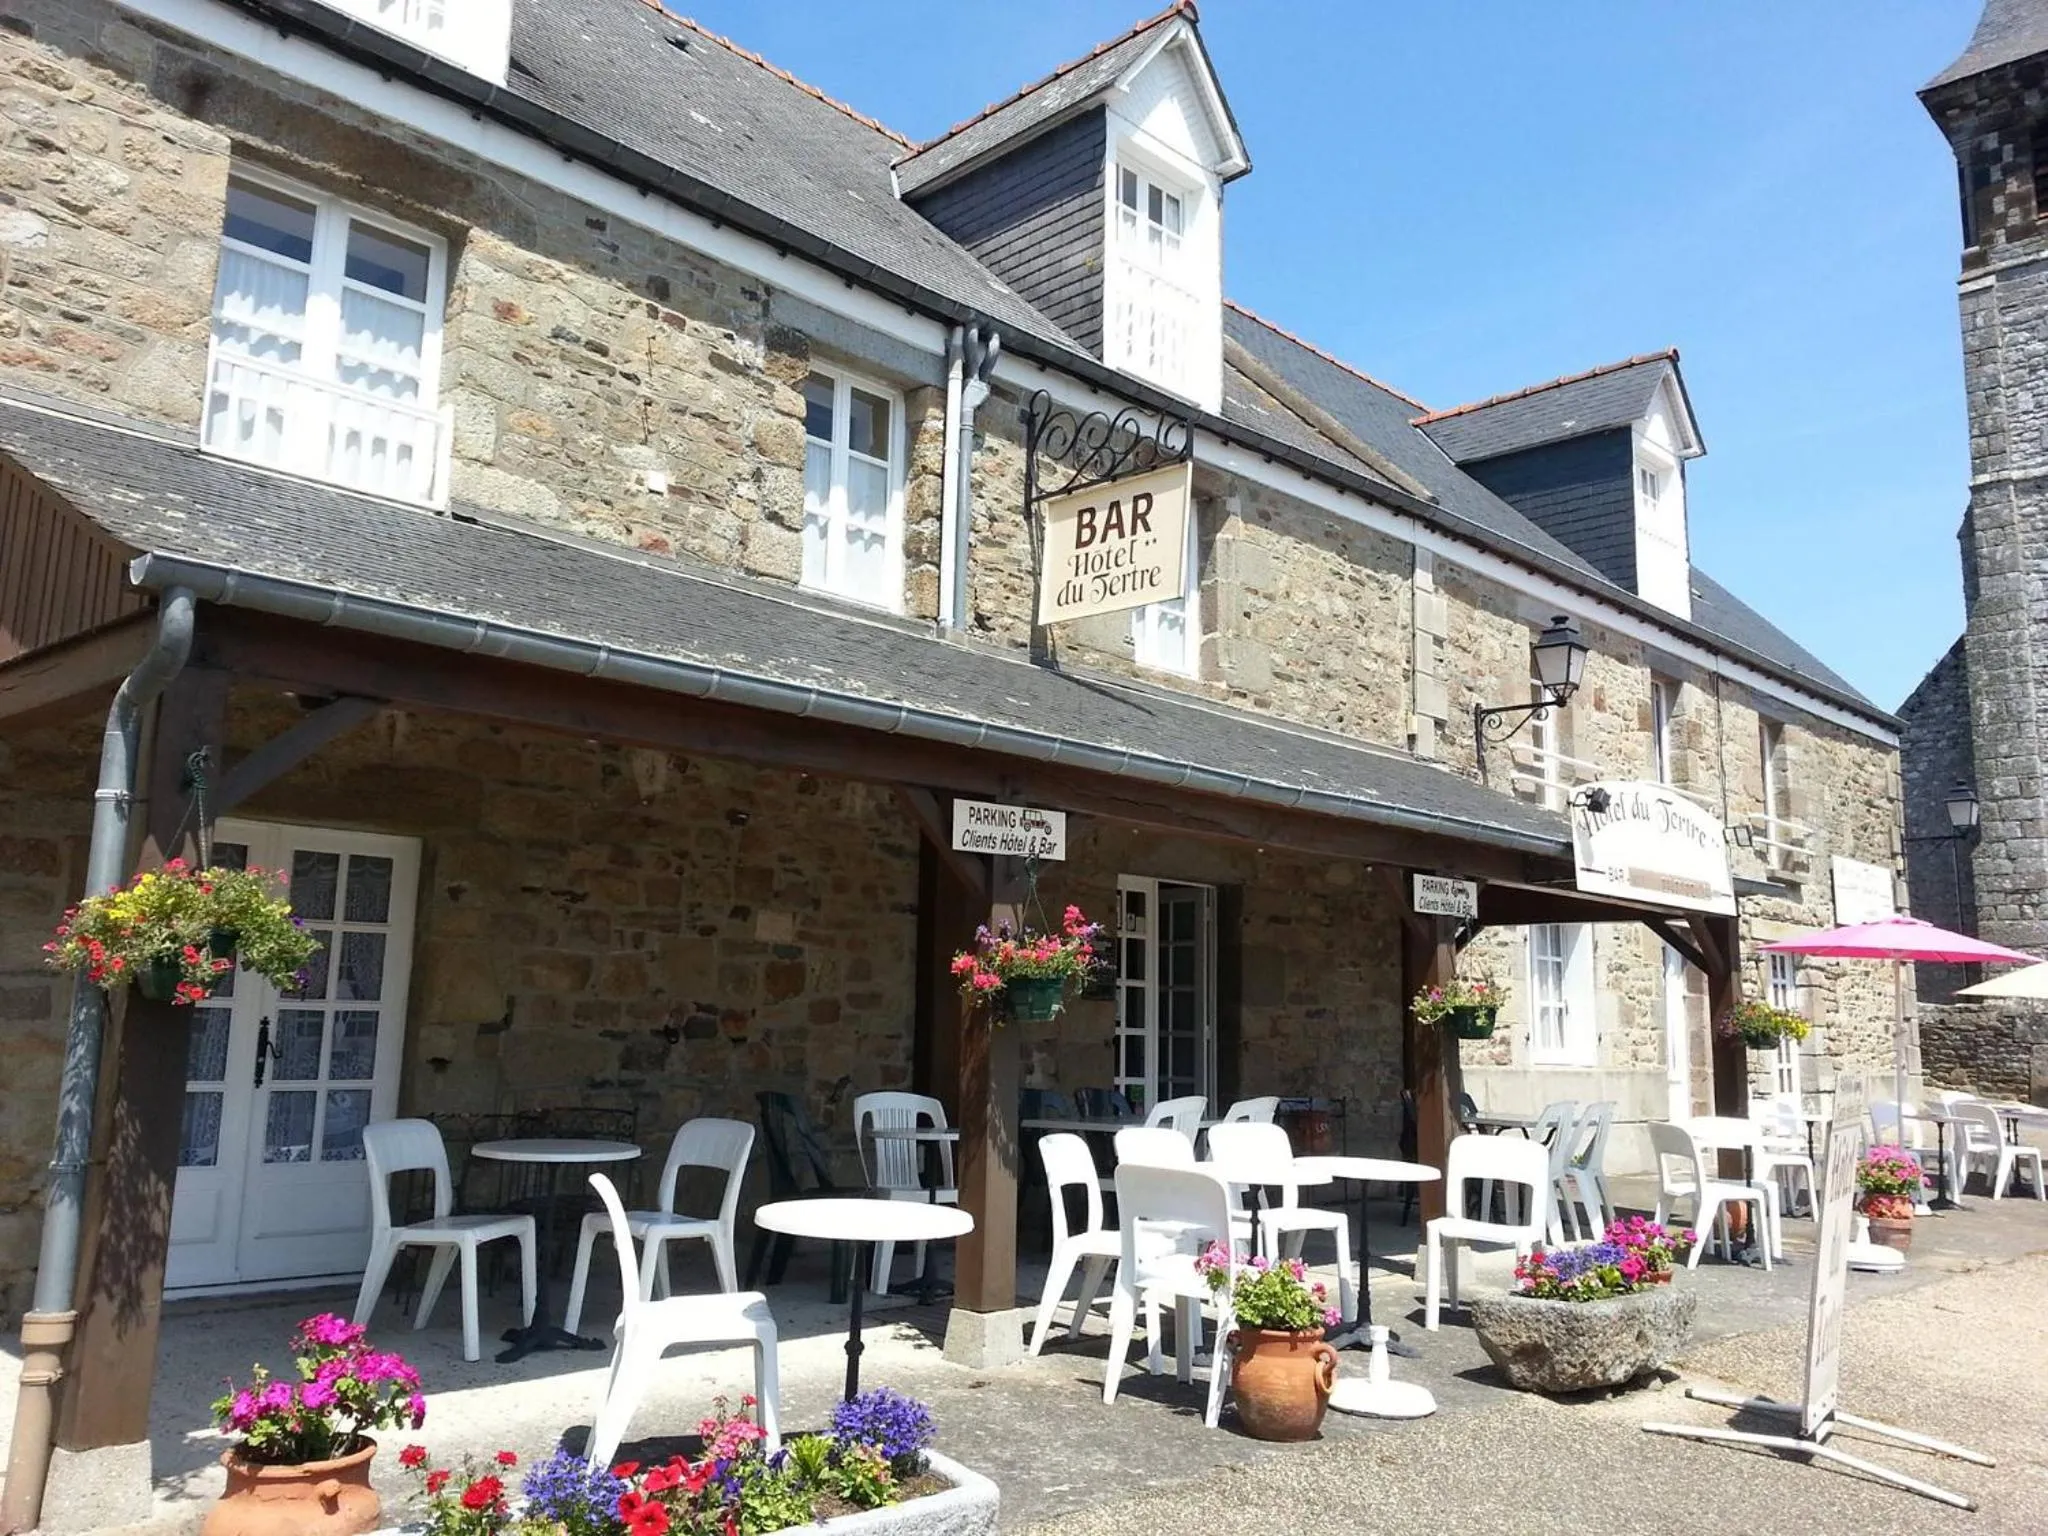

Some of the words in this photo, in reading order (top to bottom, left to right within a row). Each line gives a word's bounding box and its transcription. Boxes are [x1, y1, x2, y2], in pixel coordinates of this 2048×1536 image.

[1075, 492, 1154, 549] BAR
[1067, 540, 1138, 577] Hôtel
[1056, 580, 1084, 607] du
[1091, 566, 1161, 604] Tertre
[968, 806, 1017, 828] PARKING
[1631, 791, 1650, 821] du
[1655, 798, 1707, 848] Tertre
[961, 829, 997, 850] Clients
[1000, 833, 1027, 853] Hôtel
[1028, 836, 1037, 853] &
[1038, 837, 1058, 855] Bar
[1422, 878, 1450, 896] PARKING
